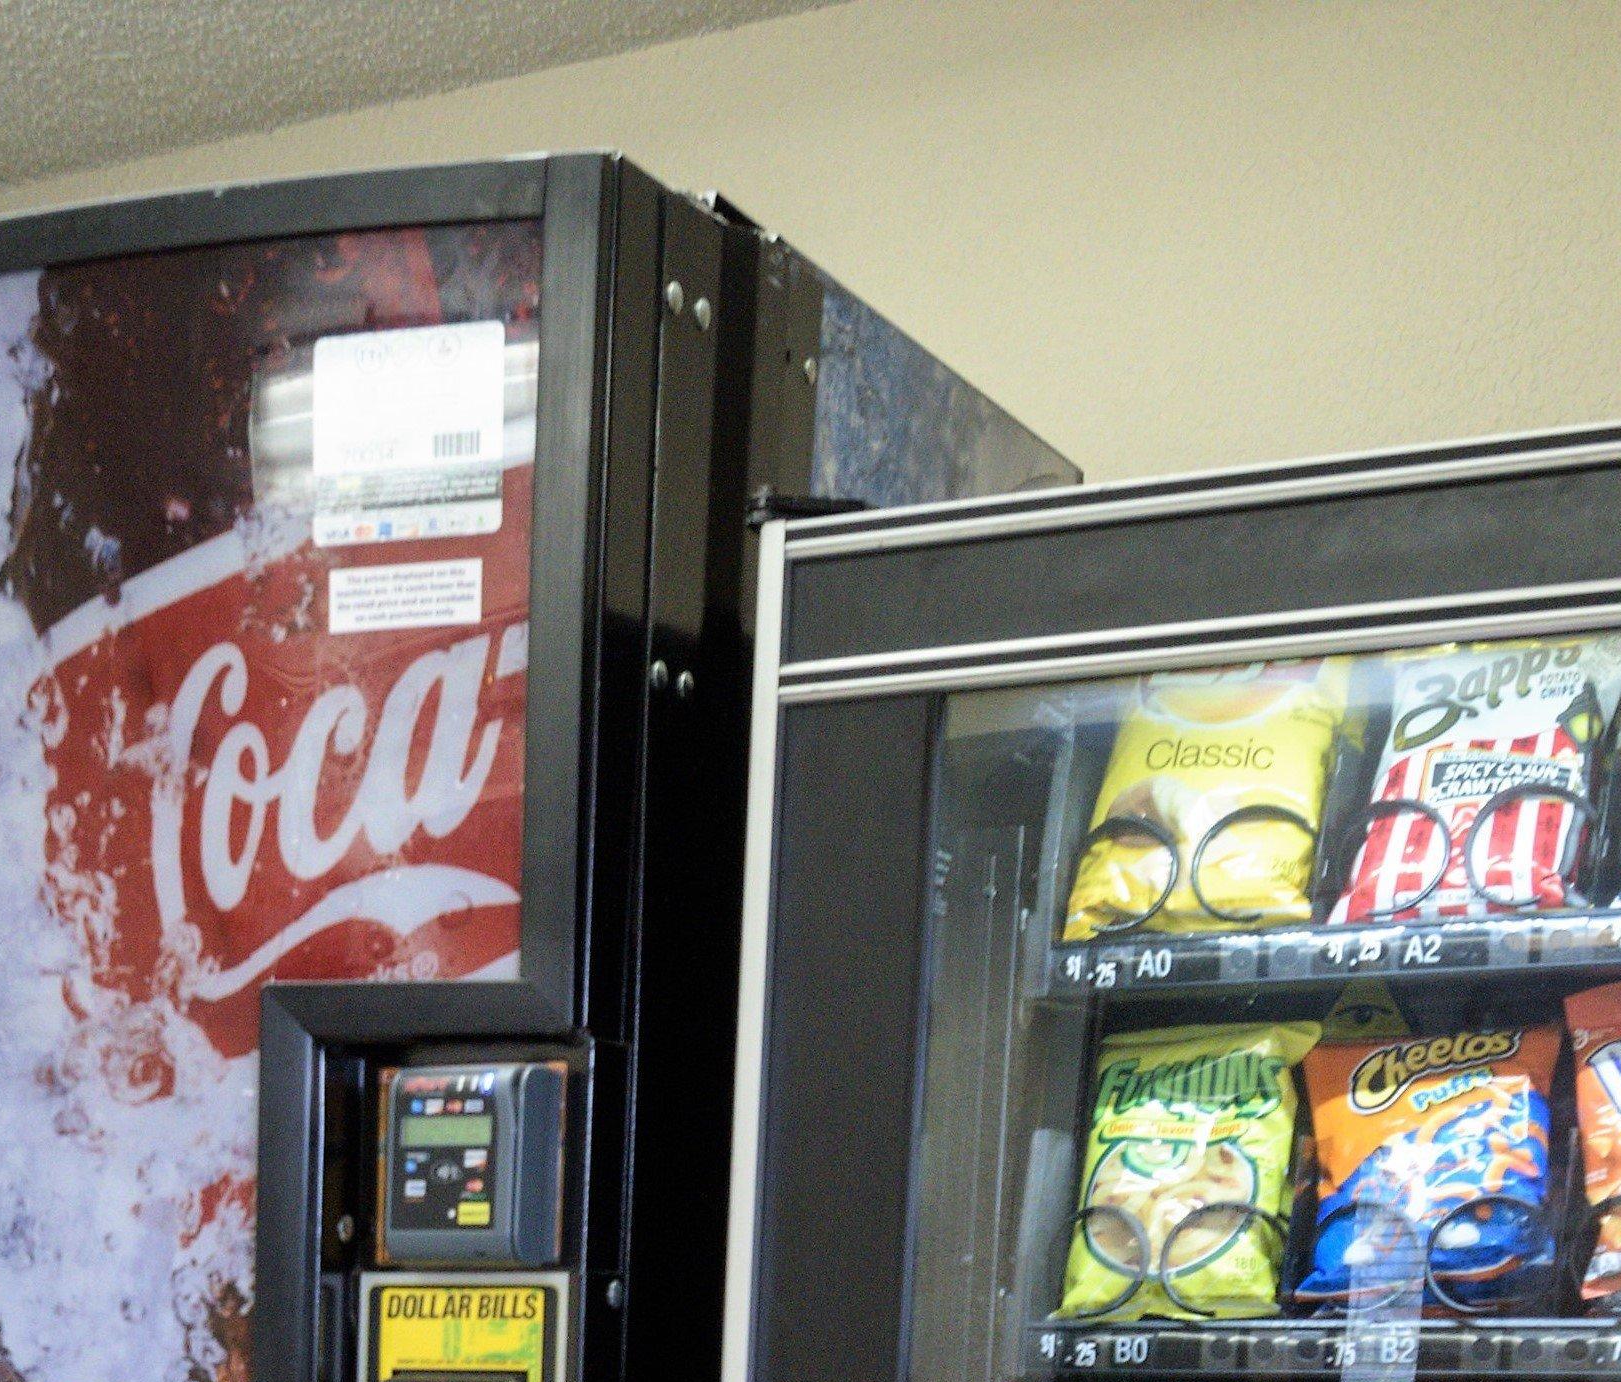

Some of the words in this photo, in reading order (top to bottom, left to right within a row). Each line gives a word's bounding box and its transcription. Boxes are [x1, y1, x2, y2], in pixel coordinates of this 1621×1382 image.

[1145, 737, 1275, 771] Classic
[1443, 761, 1493, 782] SPICY
[1496, 763, 1559, 782] CAJUN
[1402, 934, 1443, 965] A2
[1136, 950, 1173, 979] A0
[1348, 1030, 1522, 1115] Cheetos
[1411, 1069, 1494, 1112] Puffs
[386, 1291, 472, 1319] DOLLAR
[476, 1292, 540, 1320] BILLS
[1113, 1338, 1149, 1364] B0
[1379, 1338, 1416, 1363] B2
